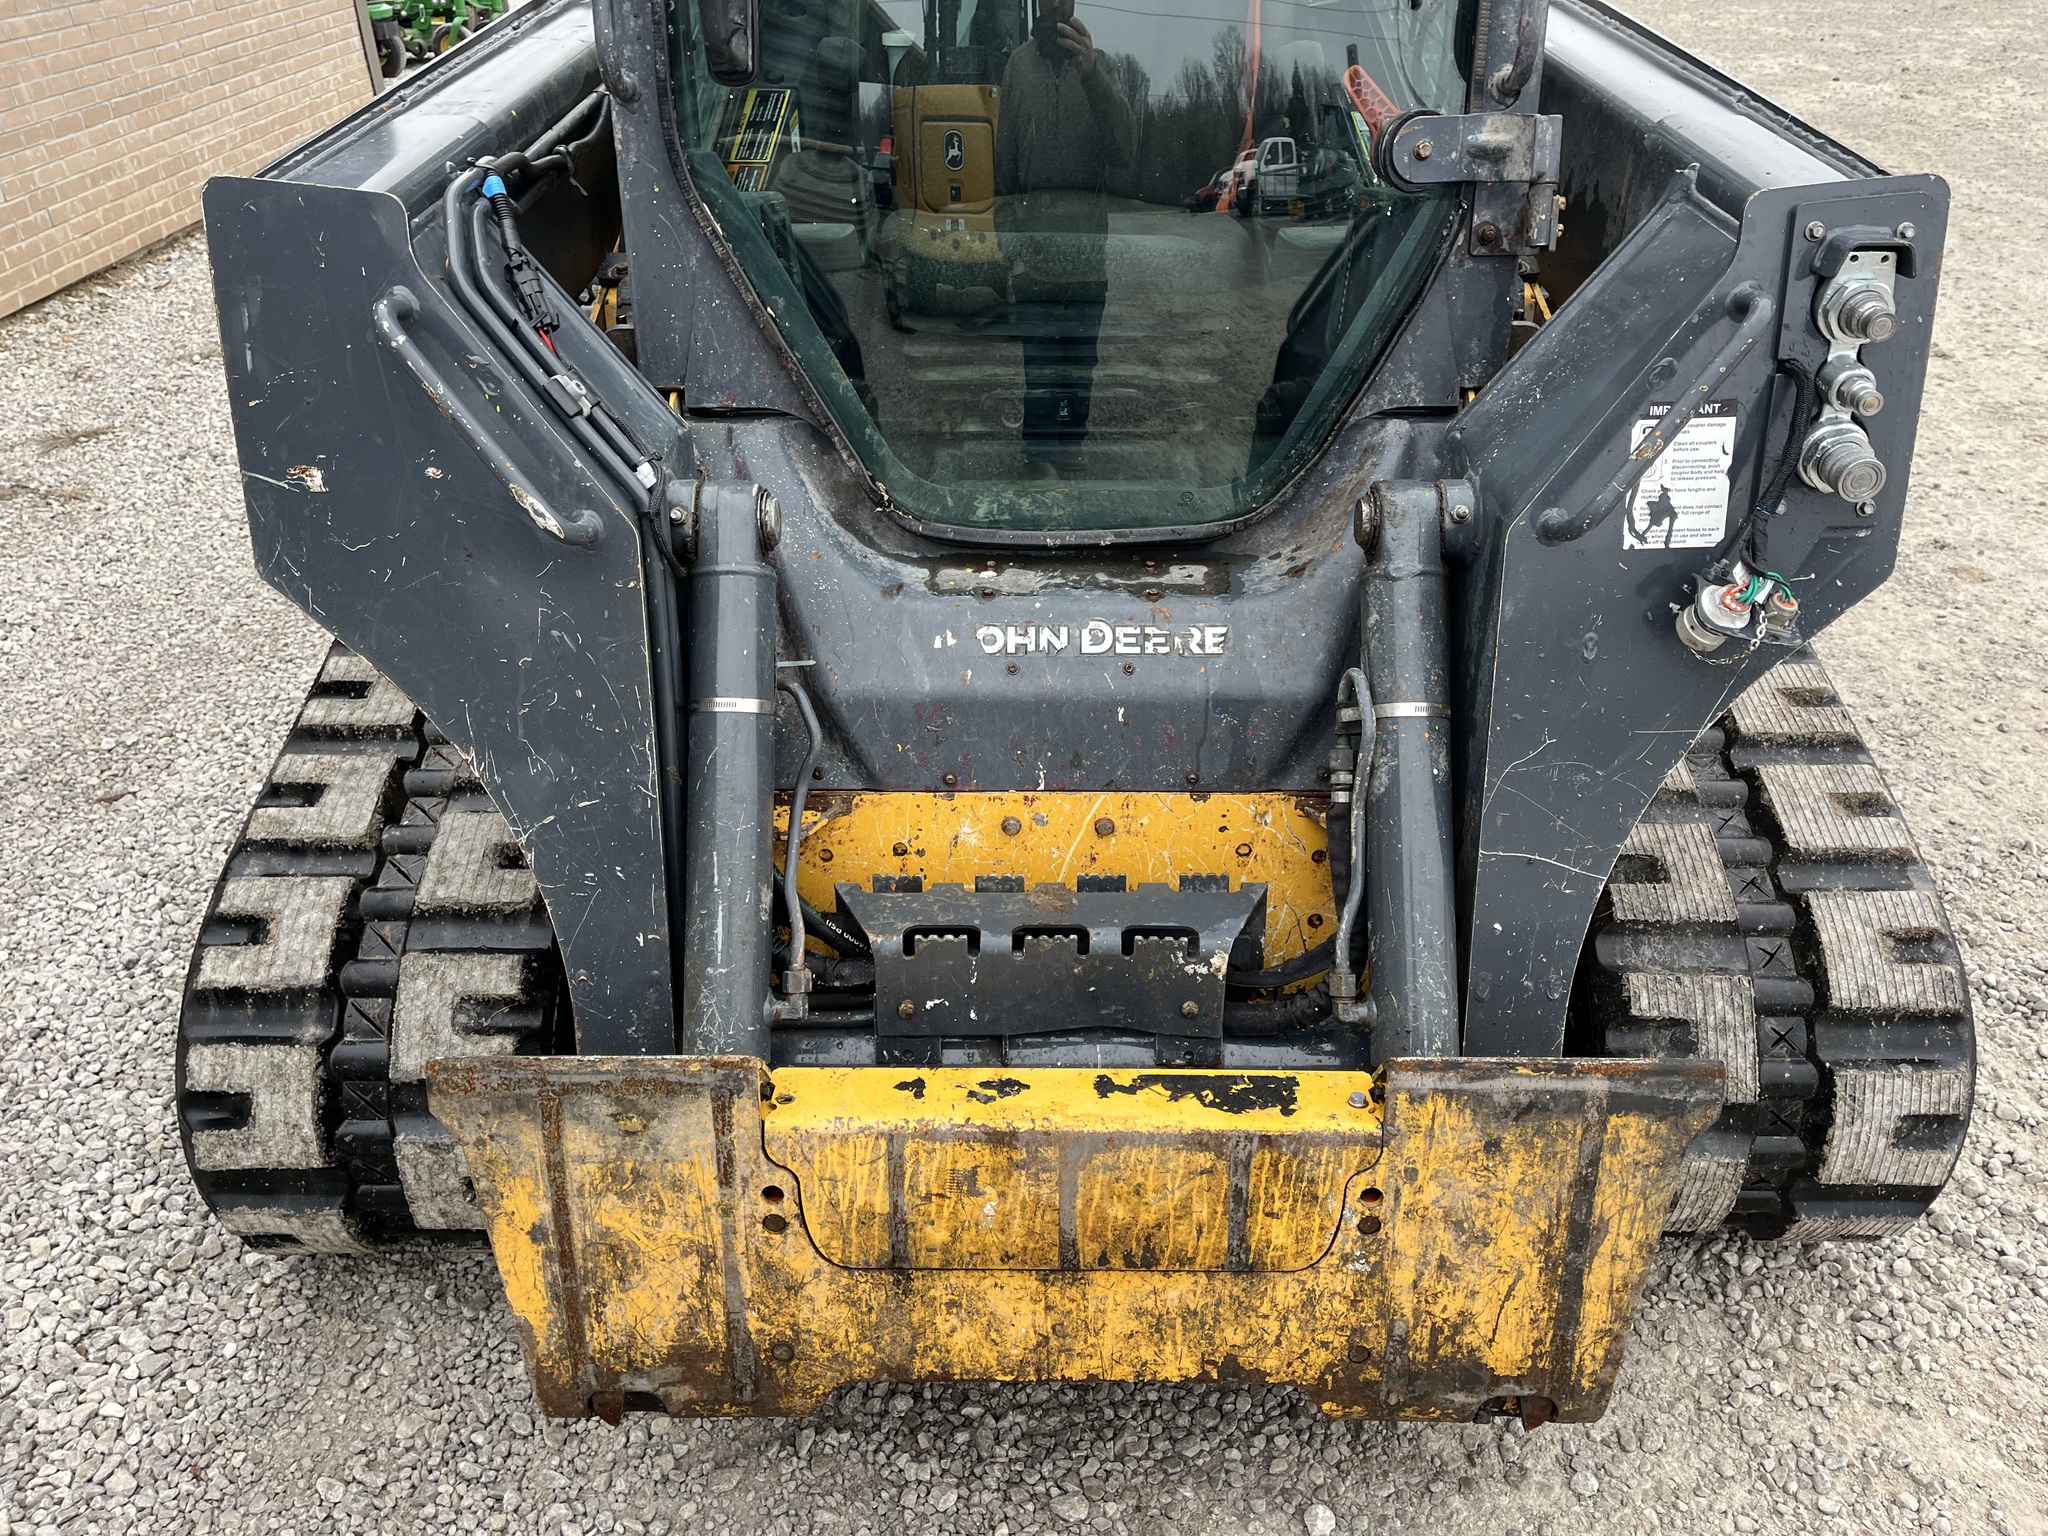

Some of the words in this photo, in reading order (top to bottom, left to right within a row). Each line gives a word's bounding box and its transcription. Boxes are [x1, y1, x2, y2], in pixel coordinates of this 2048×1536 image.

[1649, 403, 1721, 416] IMPANT
[976, 625, 1069, 655] OHN
[1079, 620, 1229, 655] DEERE
